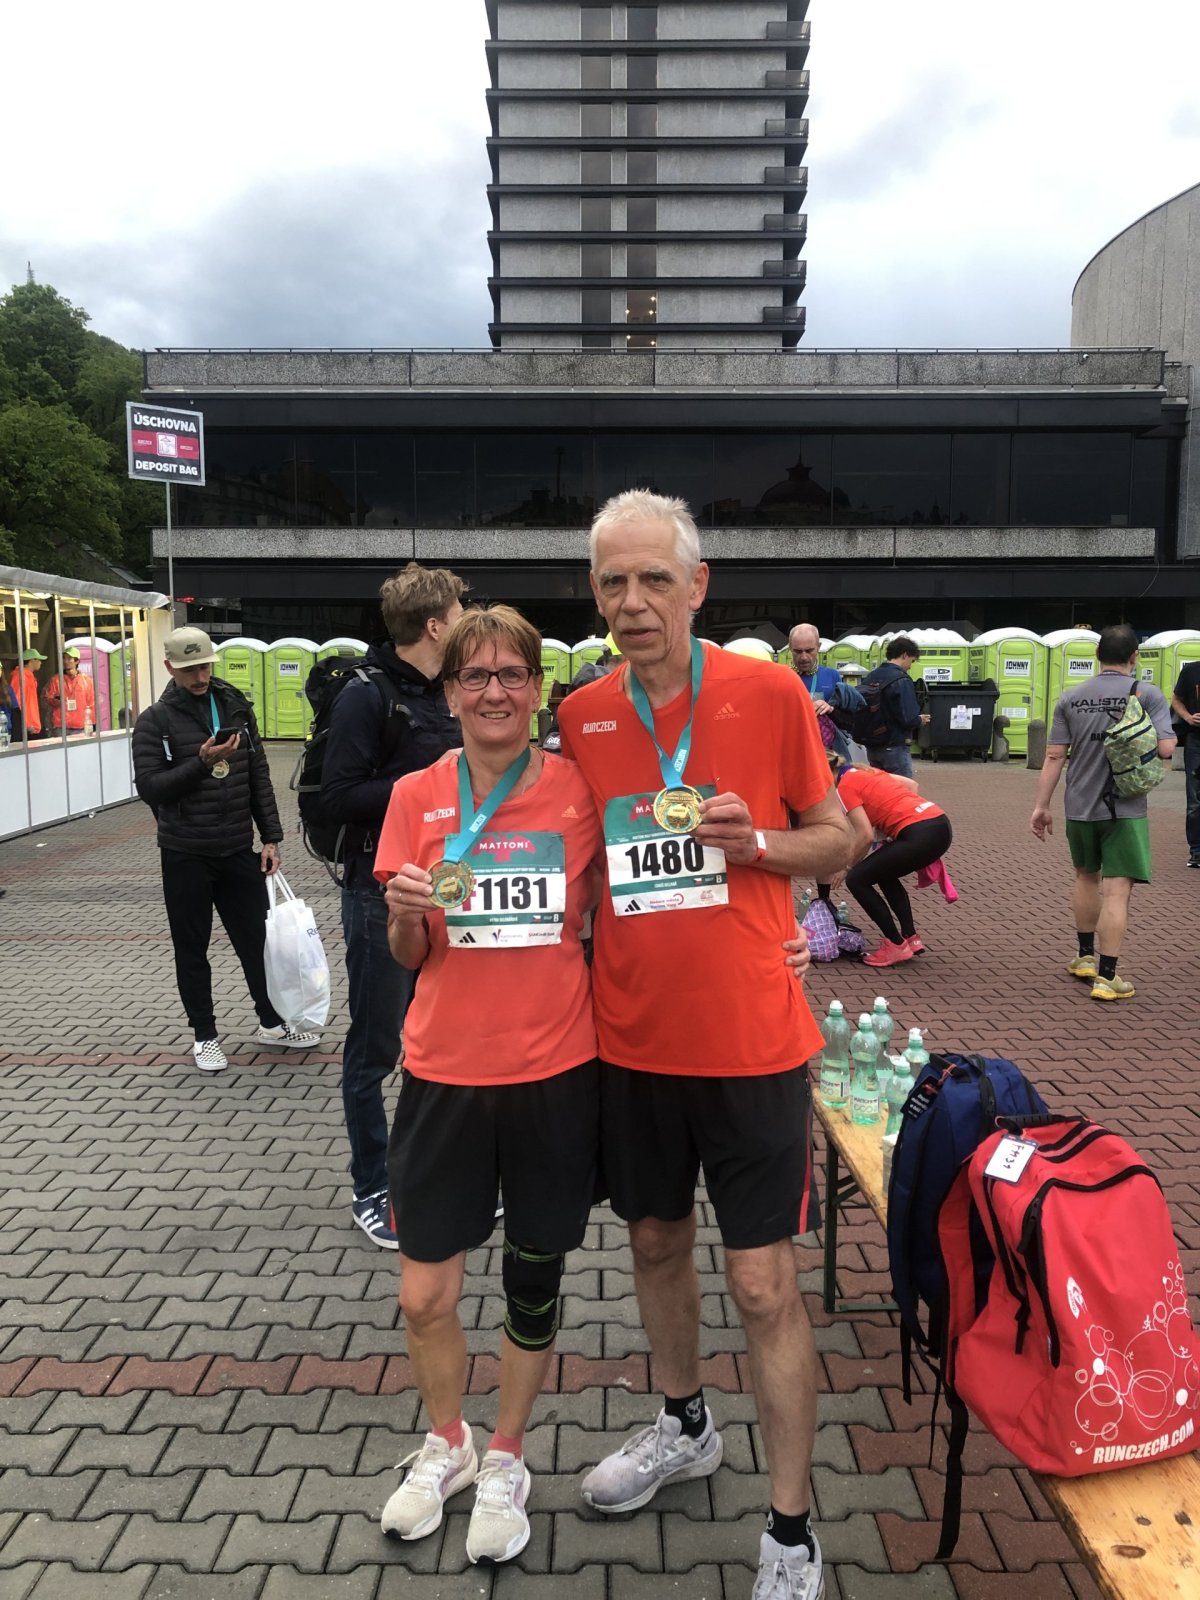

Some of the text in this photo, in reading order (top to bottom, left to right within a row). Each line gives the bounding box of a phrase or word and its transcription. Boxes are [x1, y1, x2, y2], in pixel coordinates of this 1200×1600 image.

[133, 412, 197, 433] ÚSCHOVNA
[135, 460, 198, 476] DEPOSIT BAG
[1005, 660, 1029, 670] JOHNNY
[1069, 660, 1093, 670] JOHNNY
[1071, 697, 1128, 709] KALISTA
[582, 720, 617, 734] RUNCZECH
[479, 841, 529, 850] MATTONI
[625, 837, 705, 879] 1480
[715, 874, 723, 884] B
[1093, 1417, 1195, 1465] RUNCZECH.COM
